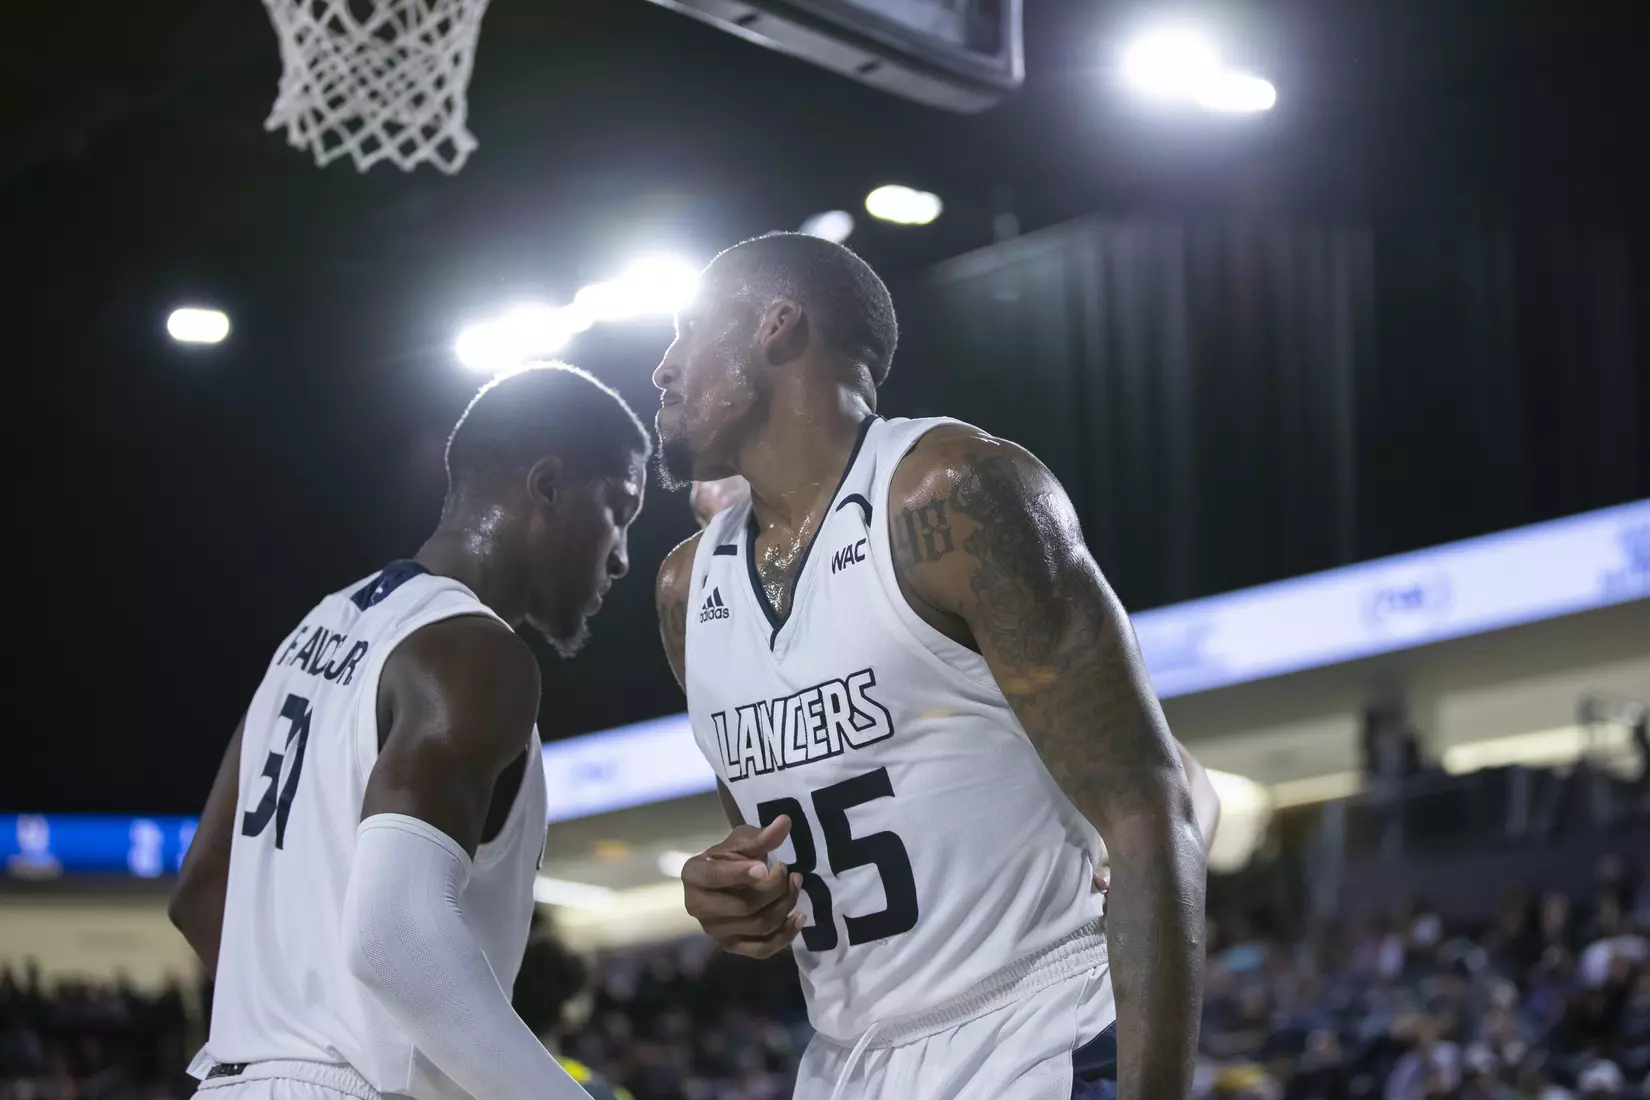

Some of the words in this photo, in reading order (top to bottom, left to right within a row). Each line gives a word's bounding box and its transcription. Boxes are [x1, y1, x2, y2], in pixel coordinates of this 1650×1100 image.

[831, 539, 866, 574] WAC
[700, 607, 730, 624] adidas
[241, 693, 313, 850] 31
[711, 668, 894, 783] LANCERS
[757, 766, 919, 952] 35
